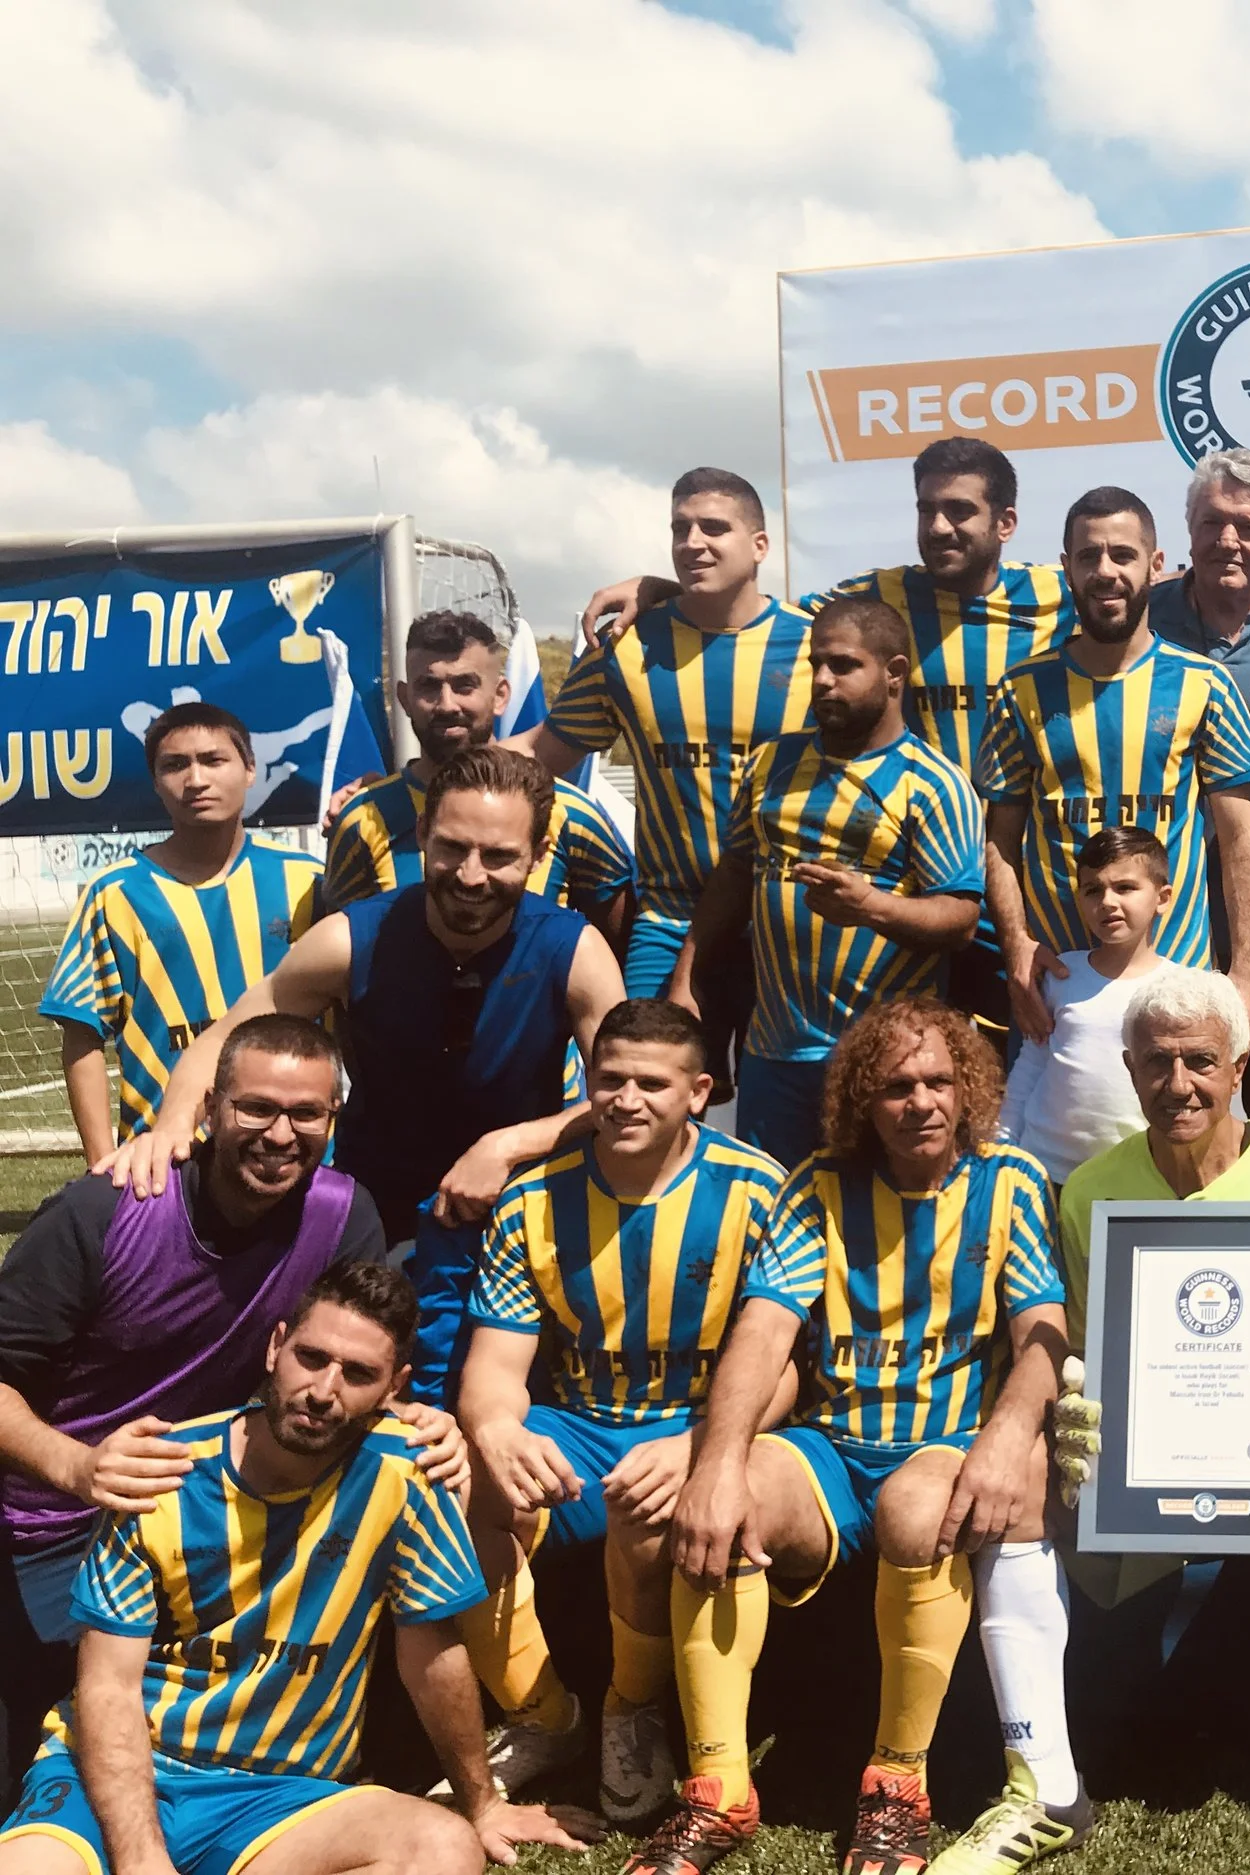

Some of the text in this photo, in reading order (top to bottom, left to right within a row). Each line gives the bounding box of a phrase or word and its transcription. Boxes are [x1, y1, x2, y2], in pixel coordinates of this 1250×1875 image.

[857, 372, 1137, 436] RECORD
[1177, 374, 1230, 457] WOR
[132, 589, 233, 667] אור
[1185, 1272, 1235, 1292] GUINNESS
[1180, 1298, 1240, 1334] WORLD RECORDS
[1175, 1343, 1242, 1352] CERTIFICATE
